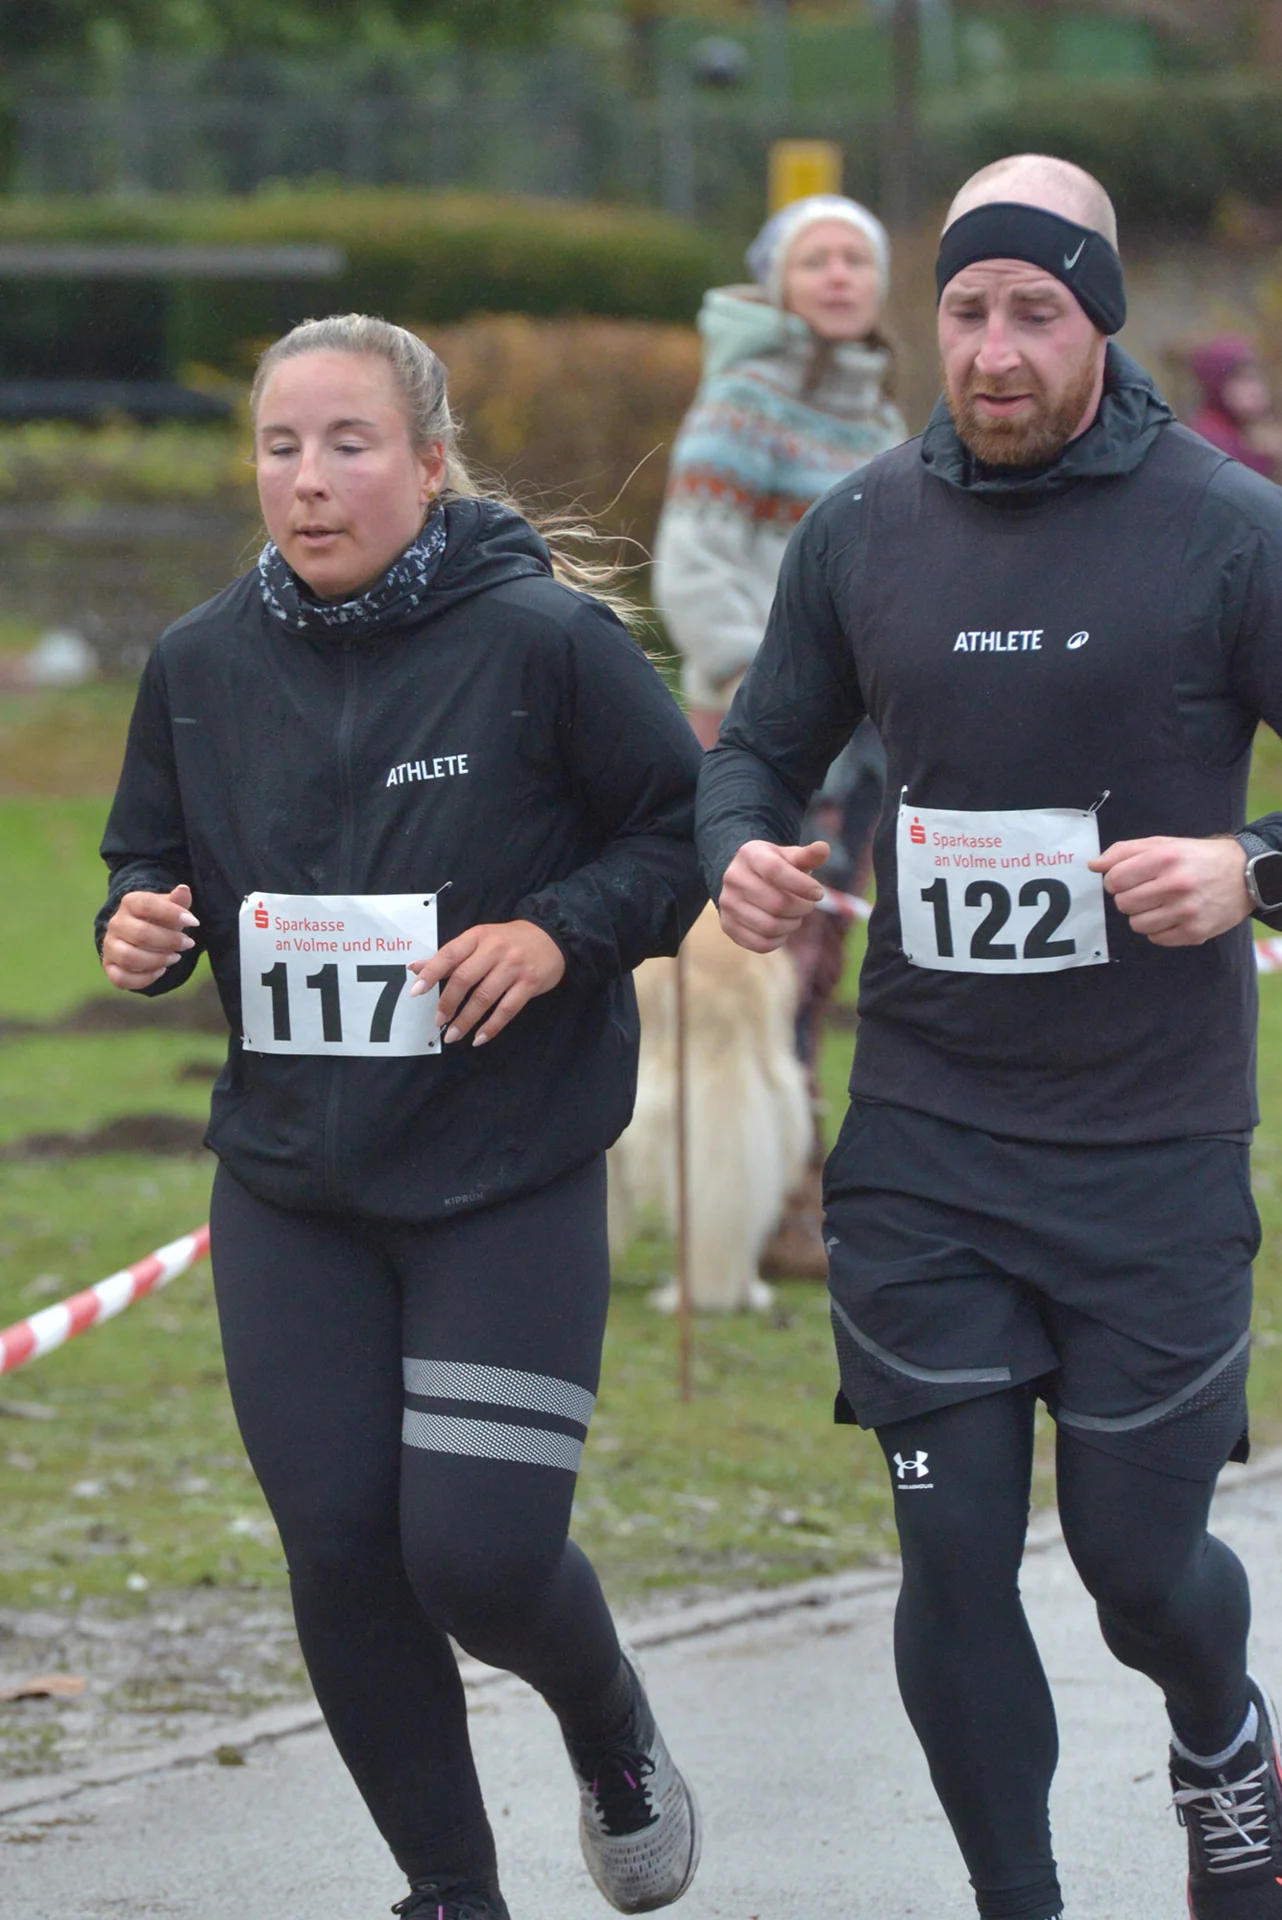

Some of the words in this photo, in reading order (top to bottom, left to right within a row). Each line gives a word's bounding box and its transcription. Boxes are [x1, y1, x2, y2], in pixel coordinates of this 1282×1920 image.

[953, 629, 1044, 652] ATHLETE
[386, 753, 469, 788] ATHLETE
[932, 832, 1003, 849] Sparkasse
[935, 855, 950, 867] an
[953, 854, 997, 869] Volme
[1001, 854, 1031, 869] und
[1035, 851, 1075, 867] Ruhr
[275, 917, 345, 933] Sparkasse
[920, 877, 1076, 960] 122
[275, 939, 291, 951] an
[293, 938, 338, 952] Volme
[342, 938, 371, 952] und
[375, 937, 413, 951] Ruhr
[261, 962, 407, 1043] 117
